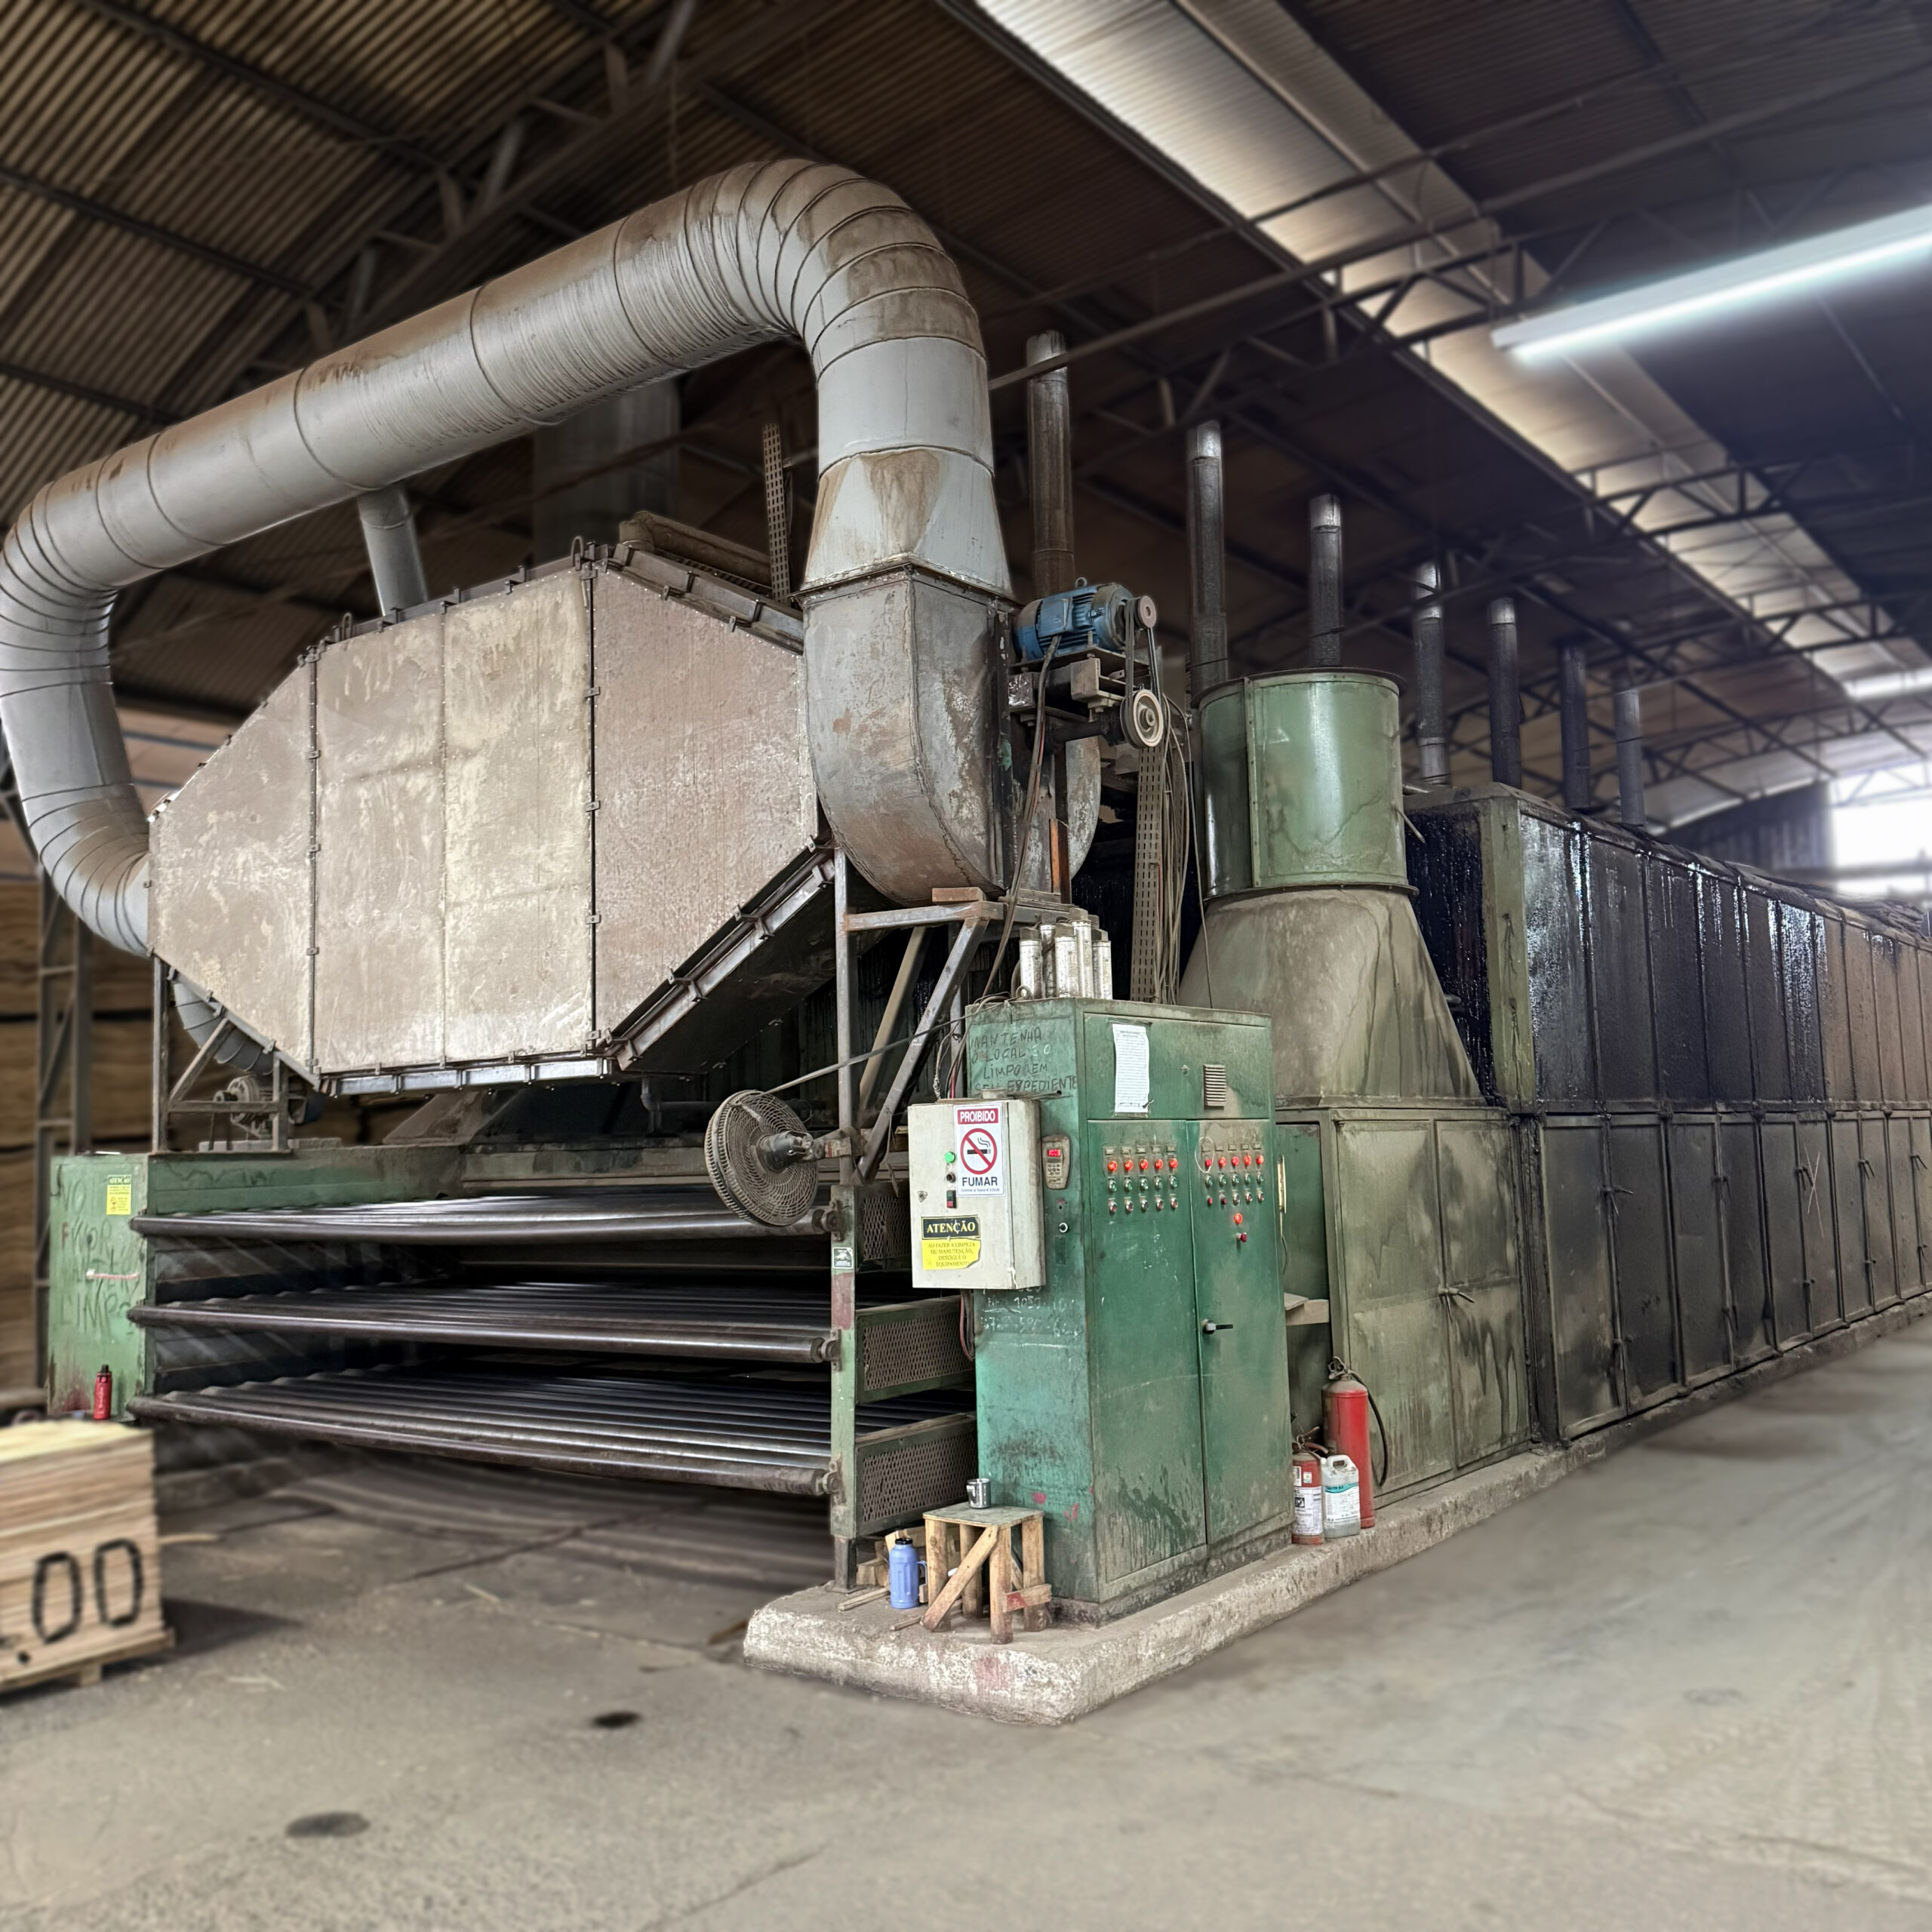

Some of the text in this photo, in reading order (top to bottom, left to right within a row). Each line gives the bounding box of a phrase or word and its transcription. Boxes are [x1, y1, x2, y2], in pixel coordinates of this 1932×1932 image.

[970, 1027, 1042, 1049] MANTENHA
[986, 1048, 1026, 1063] LOCAL
[1032, 1063, 1048, 1074] EM
[959, 1110, 995, 1122] PROIBIDO
[961, 1176, 998, 1186] FUMAR
[927, 1220, 976, 1234] ATENÇÃO
